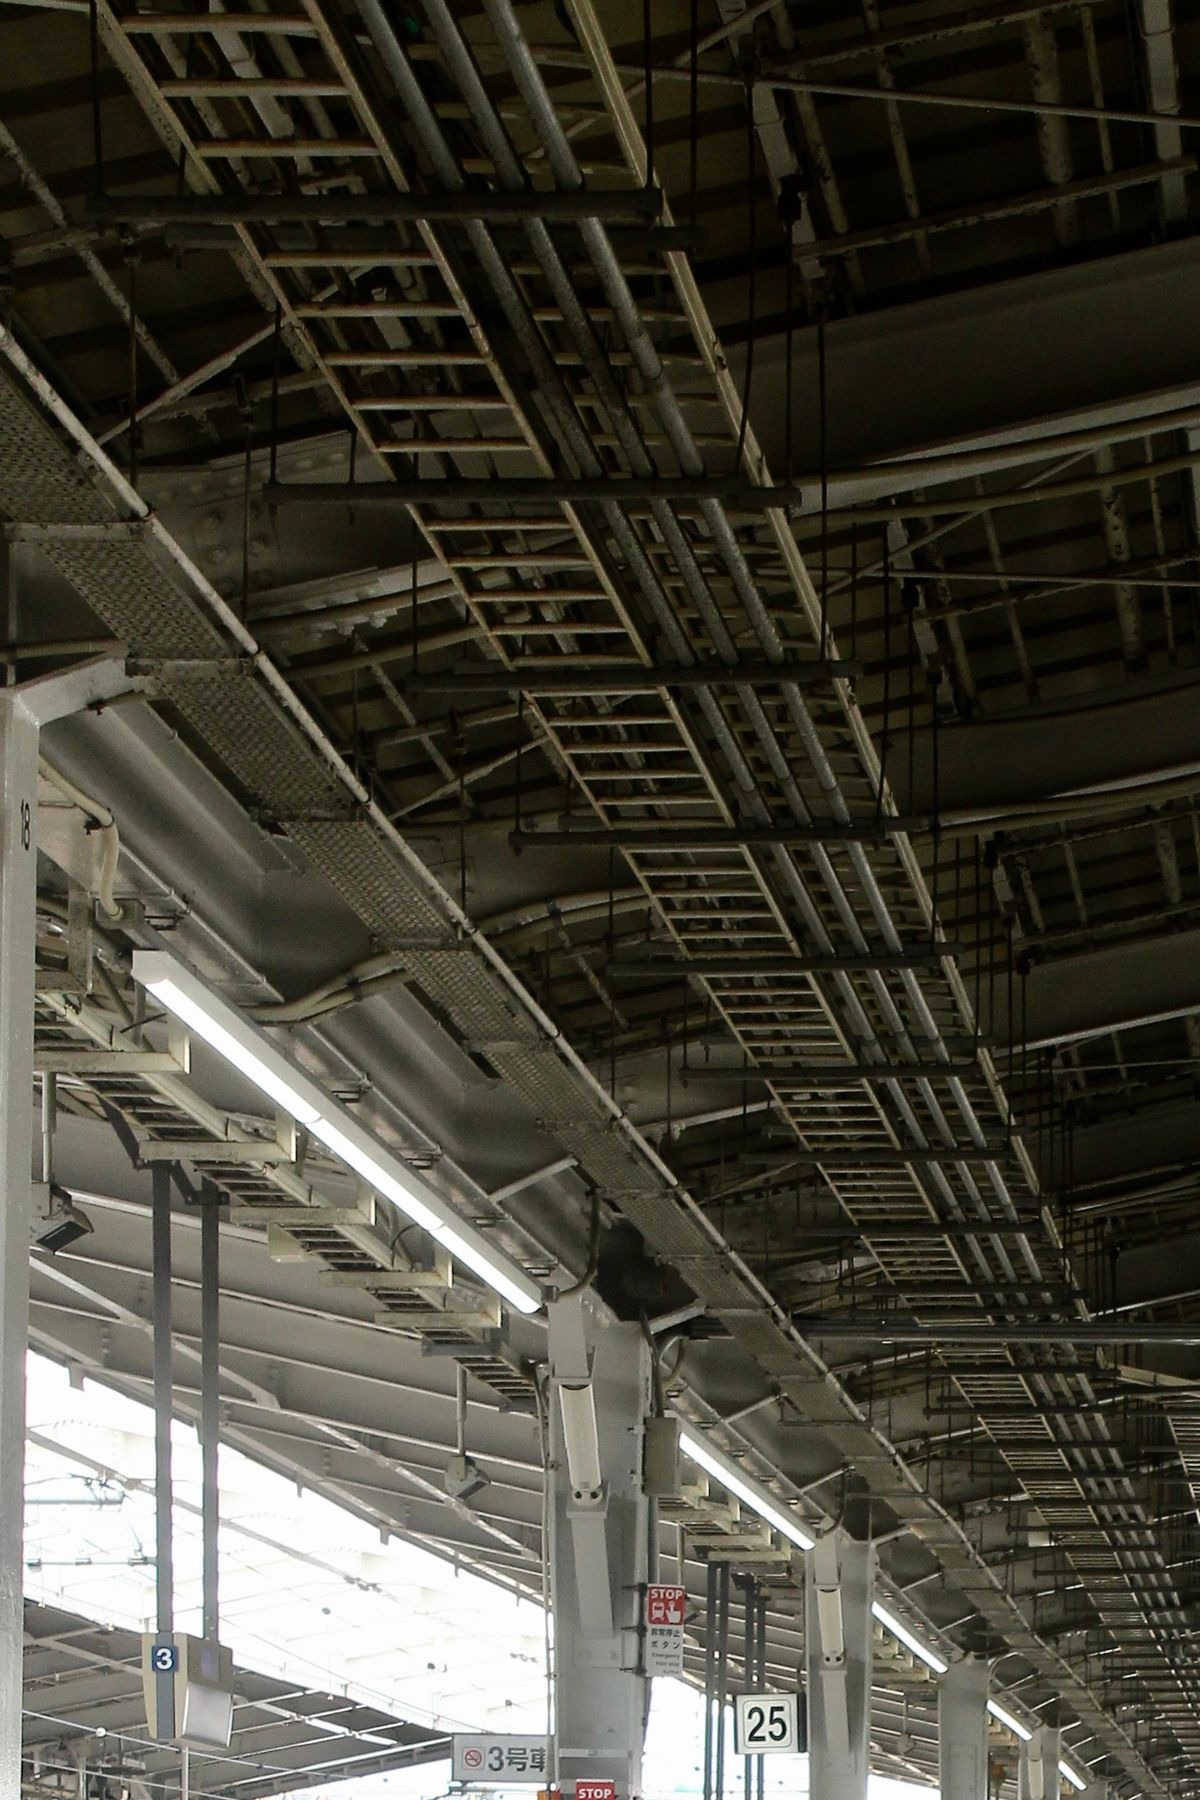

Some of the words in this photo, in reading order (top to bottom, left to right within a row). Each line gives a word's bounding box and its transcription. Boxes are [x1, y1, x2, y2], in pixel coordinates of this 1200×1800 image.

[21, 799, 31, 851] 18
[651, 1588, 683, 1599] STOP
[156, 1648, 173, 1670] 3
[747, 1706, 788, 1742] 25
[579, 1788, 612, 1799] STOP
